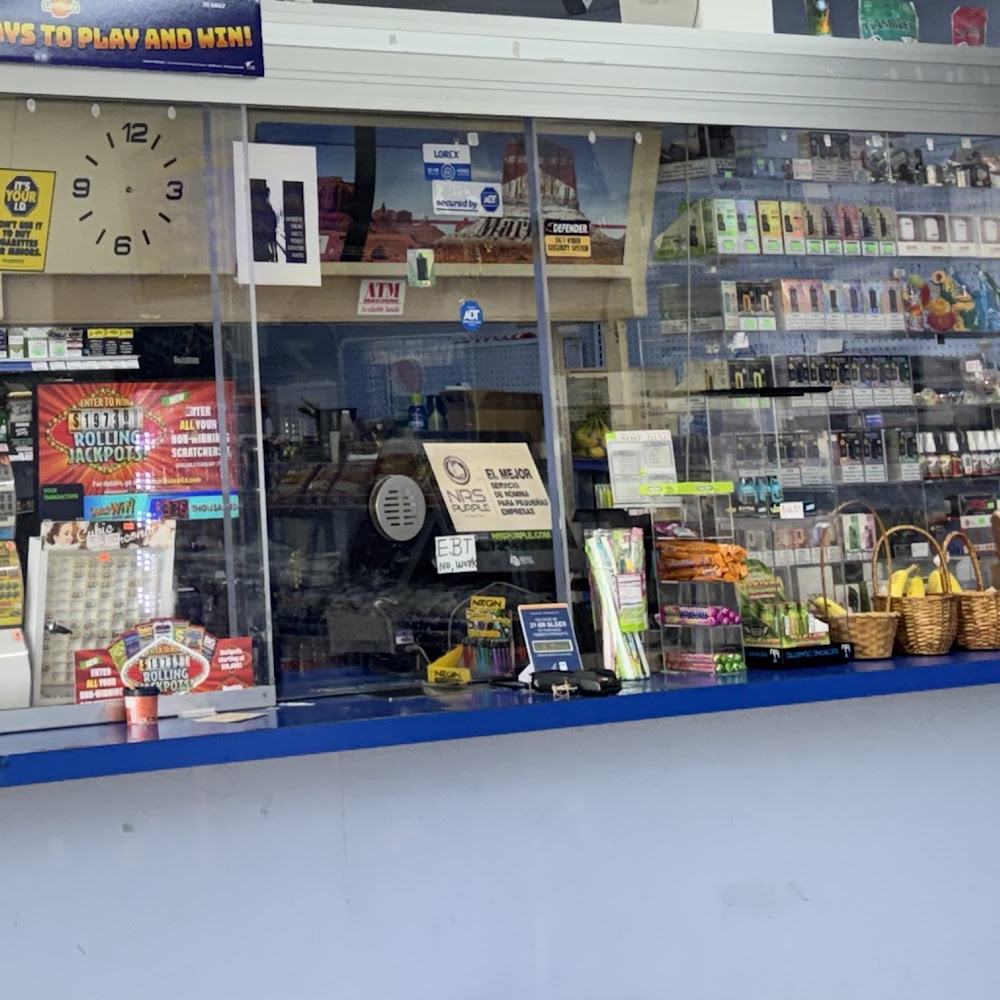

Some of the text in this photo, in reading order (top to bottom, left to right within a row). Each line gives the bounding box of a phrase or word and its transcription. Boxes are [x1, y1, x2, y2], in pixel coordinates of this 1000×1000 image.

[40, 24, 73, 48] TO
[78, 27, 140, 50] PLAY
[144, 26, 193, 50] AND
[196, 26, 253, 49] WIN!
[122, 122, 149, 144] 12
[434, 149, 460, 159] LOREX
[14, 181, 31, 191] IT'S
[72, 177, 91, 198] 9
[165, 180, 184, 200] 3
[5, 190, 37, 203] YOUR
[435, 199, 478, 210] secured by
[35, 222, 43, 230] IT
[552, 223, 589, 234] DEFENDER
[3, 229, 31, 239] TO BUY
[113, 235, 132, 256] 6
[365, 282, 400, 298] ATM
[463, 309, 480, 320] ADT
[79, 397, 104, 408] ENTER
[104, 397, 112, 406] TO
[179, 419, 218, 431] ALL YOUR
[74, 430, 140, 447] ROLLING
[68, 446, 149, 464] JACKPOTS!
[485, 468, 533, 480] EL MEJOR
[446, 488, 487, 504] NRS
[451, 503, 491, 513] PURPLE
[437, 537, 473, 558] EBT
[472, 599, 501, 607] NEON
[143, 668, 189, 682] ROLLING
[434, 670, 460, 678] NEON
[86, 677, 117, 688] ALL YOUR
